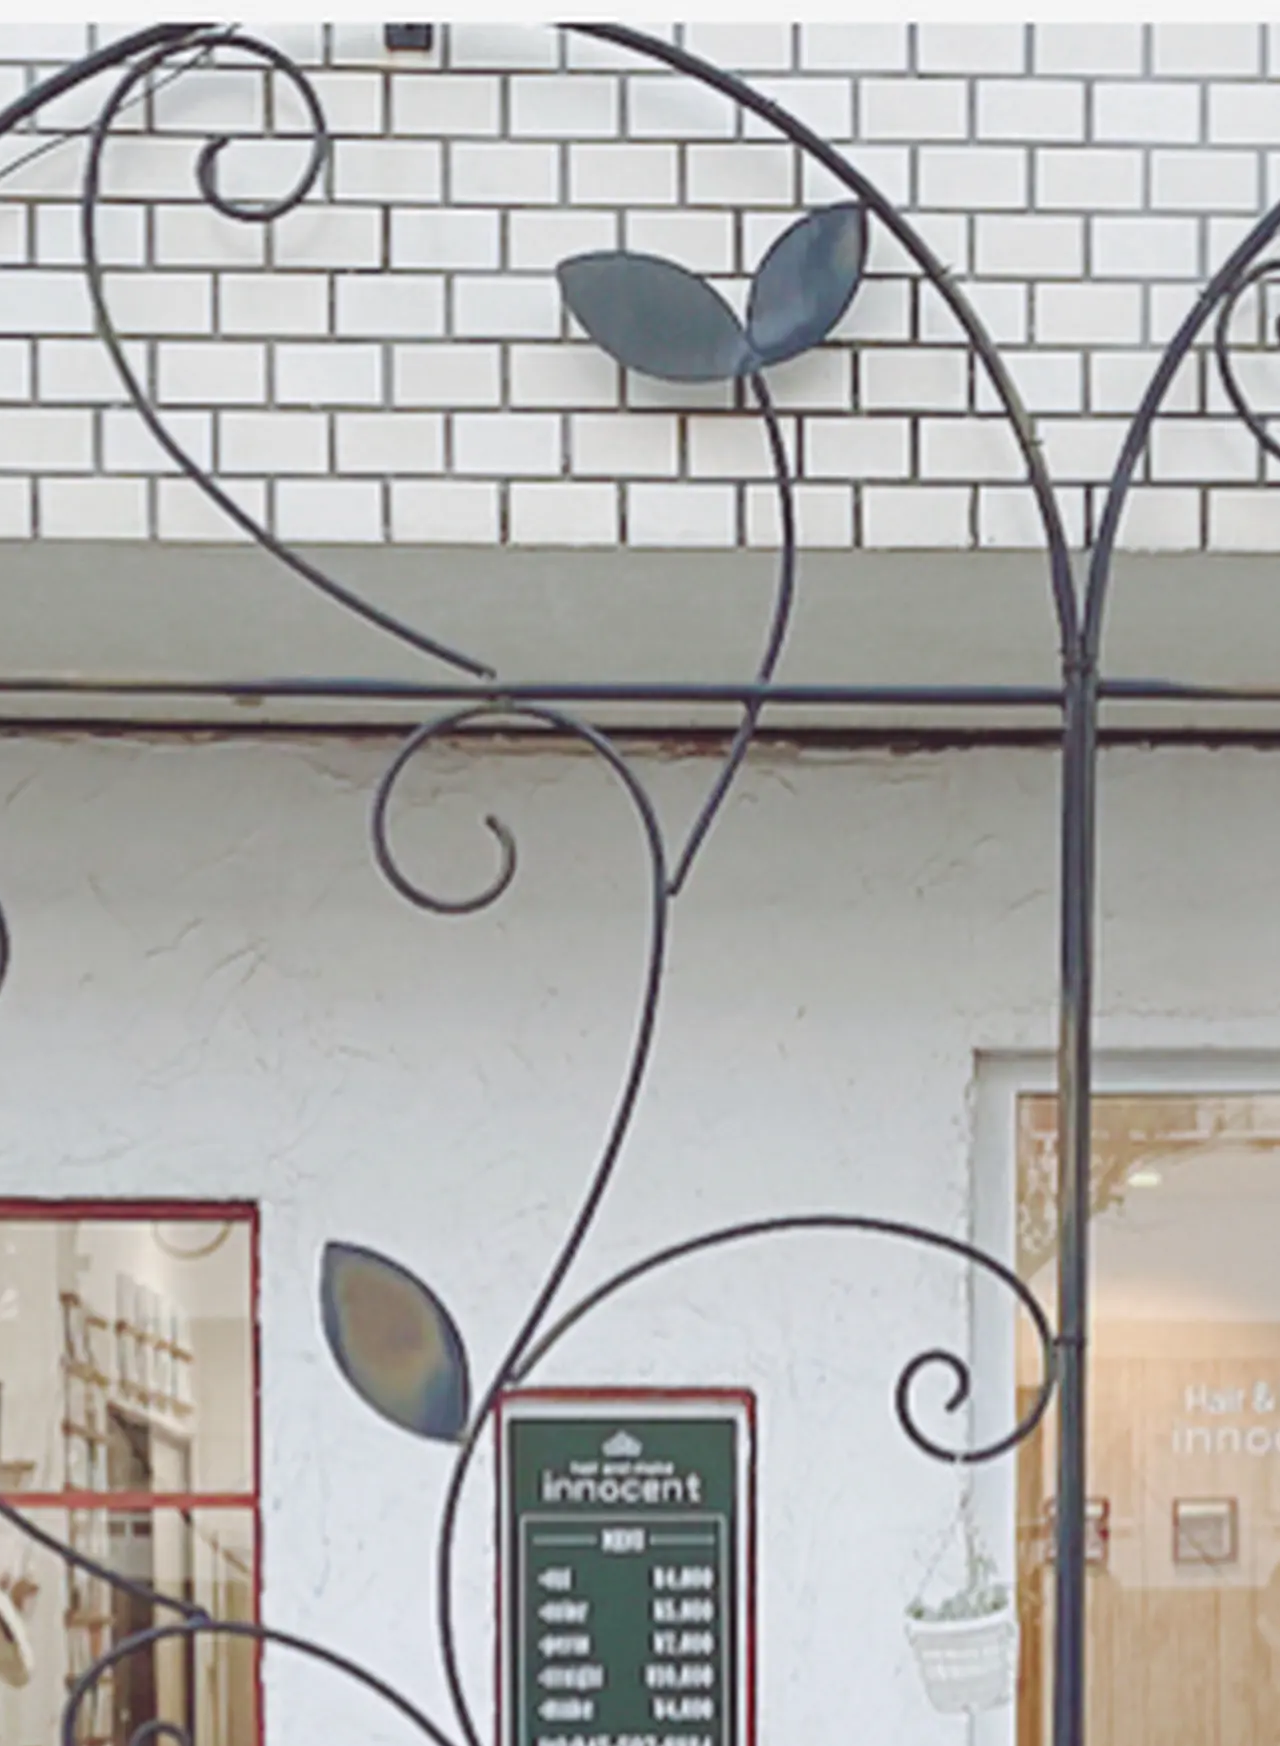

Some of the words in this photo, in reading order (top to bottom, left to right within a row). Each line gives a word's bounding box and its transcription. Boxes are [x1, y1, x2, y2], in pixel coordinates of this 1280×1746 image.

[1185, 1382, 1244, 1412] Hair
[1252, 1381, 1275, 1413] &
[542, 1468, 701, 1502] innocent
